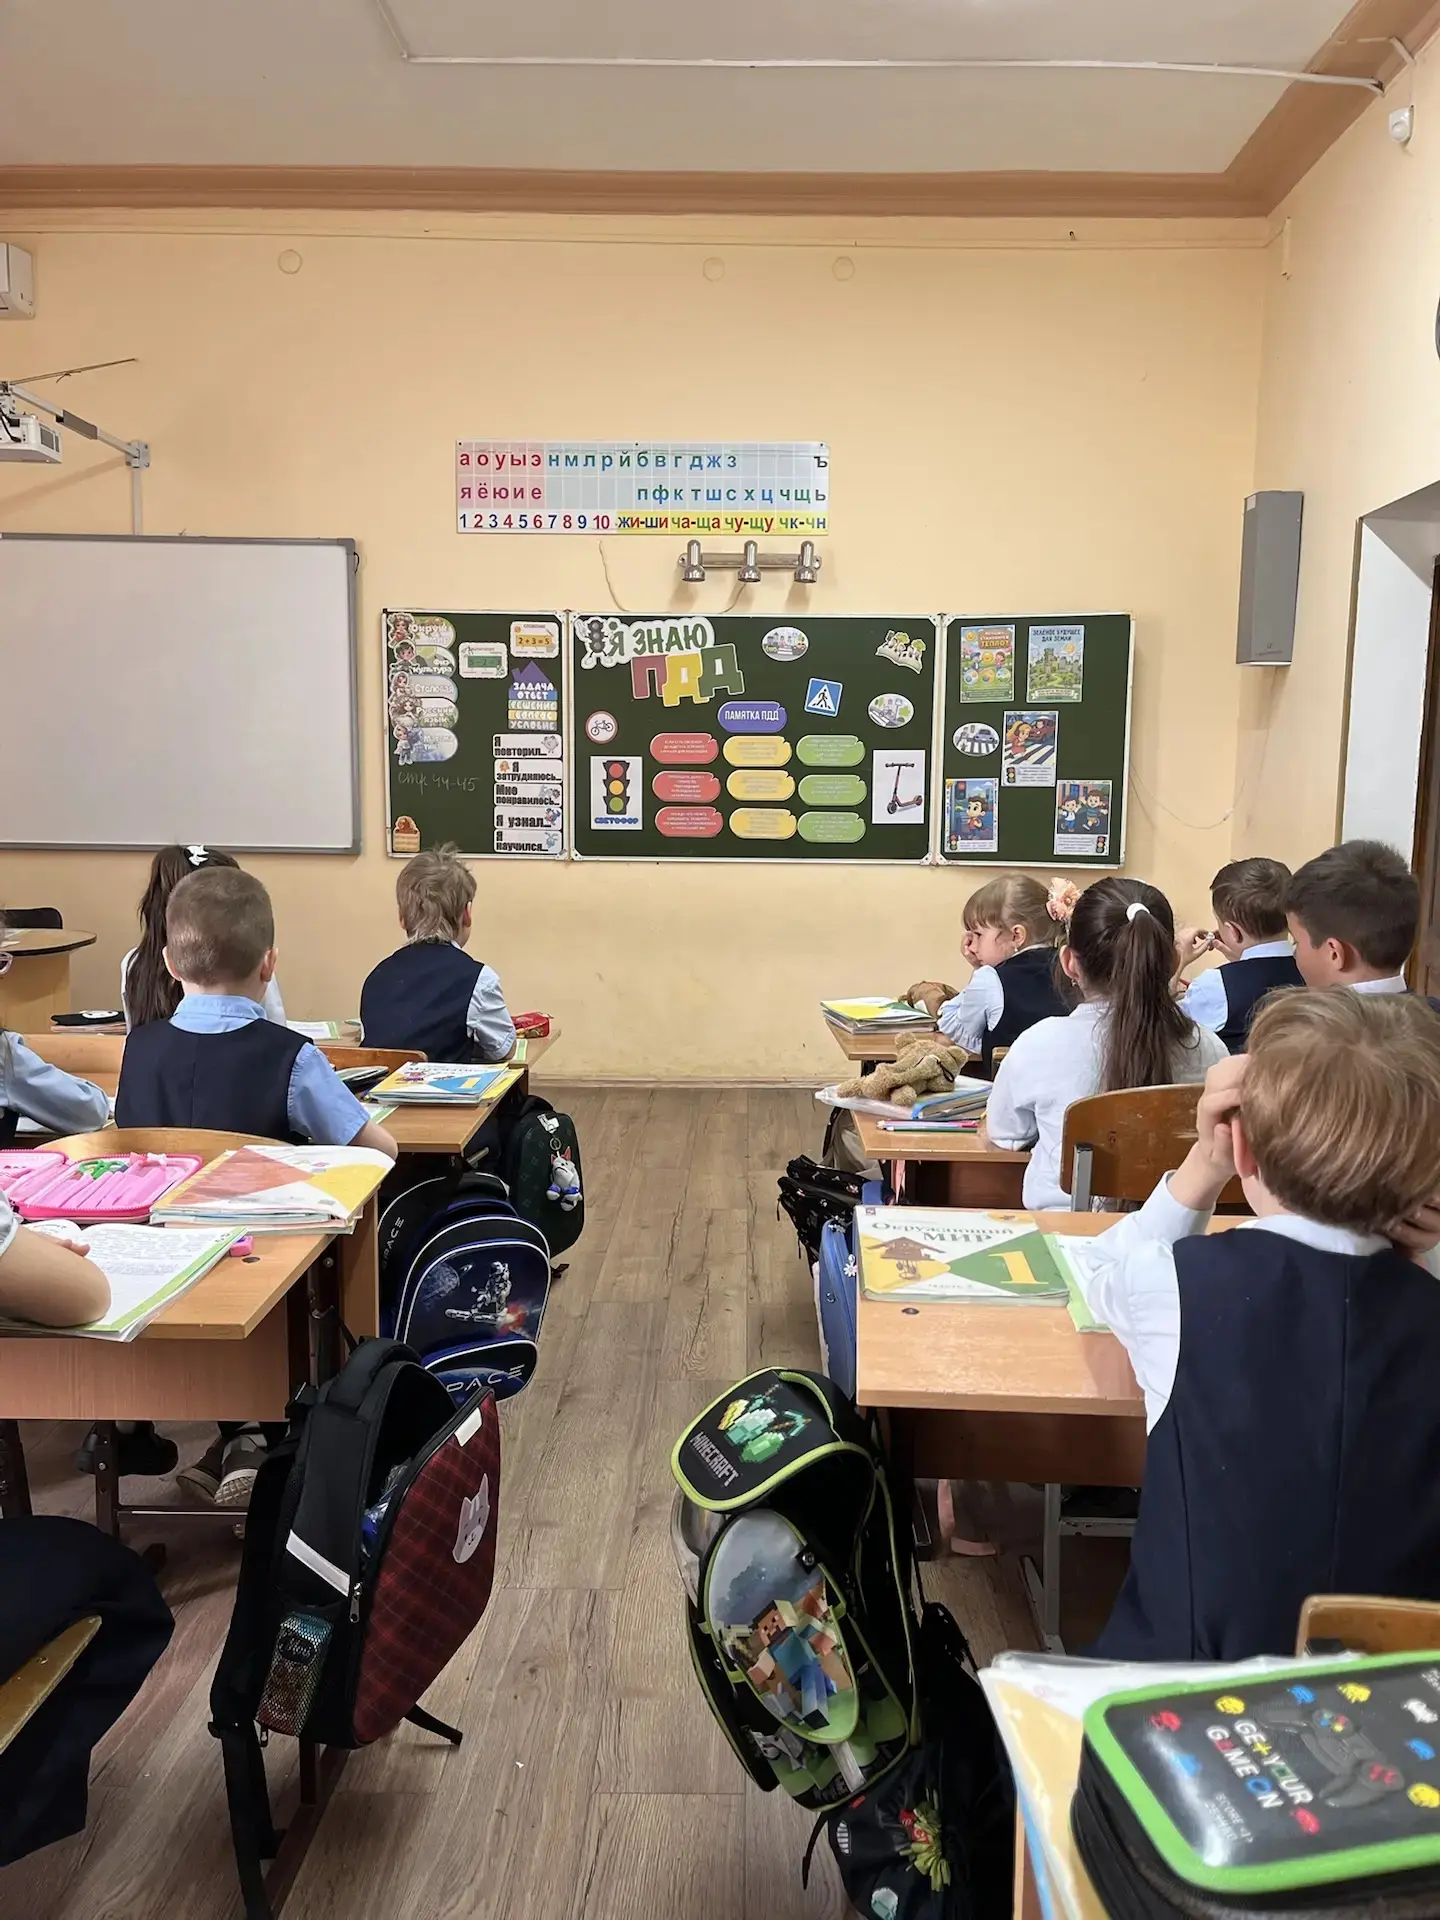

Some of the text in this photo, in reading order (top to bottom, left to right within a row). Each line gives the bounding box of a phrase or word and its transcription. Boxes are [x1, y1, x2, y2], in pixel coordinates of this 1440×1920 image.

[460, 513, 827, 532] 1 2 3 4 5 6 7 8 9 10 жи-ши ча-ща чу-щу чк-чн
[608, 622, 708, 657] Я ЗНАЮ
[631, 643, 745, 707] ПДД
[415, 684, 454, 693] Столовая
[513, 682, 554, 691] ЗАДАЧА
[517, 691, 549, 700] ОТВЕТ
[724, 710, 780, 721] ПАМЯТКА ПДД
[510, 721, 556, 731] УСЛОВИЕ
[494, 736, 501, 747] Я
[512, 761, 519, 772] Я
[496, 814, 503, 827] Я
[496, 831, 503, 842] Я
[988, 1251, 1049, 1285] 1
[446, 1364, 526, 1393] PACE
[689, 1431, 740, 1488] MINECRAFT
